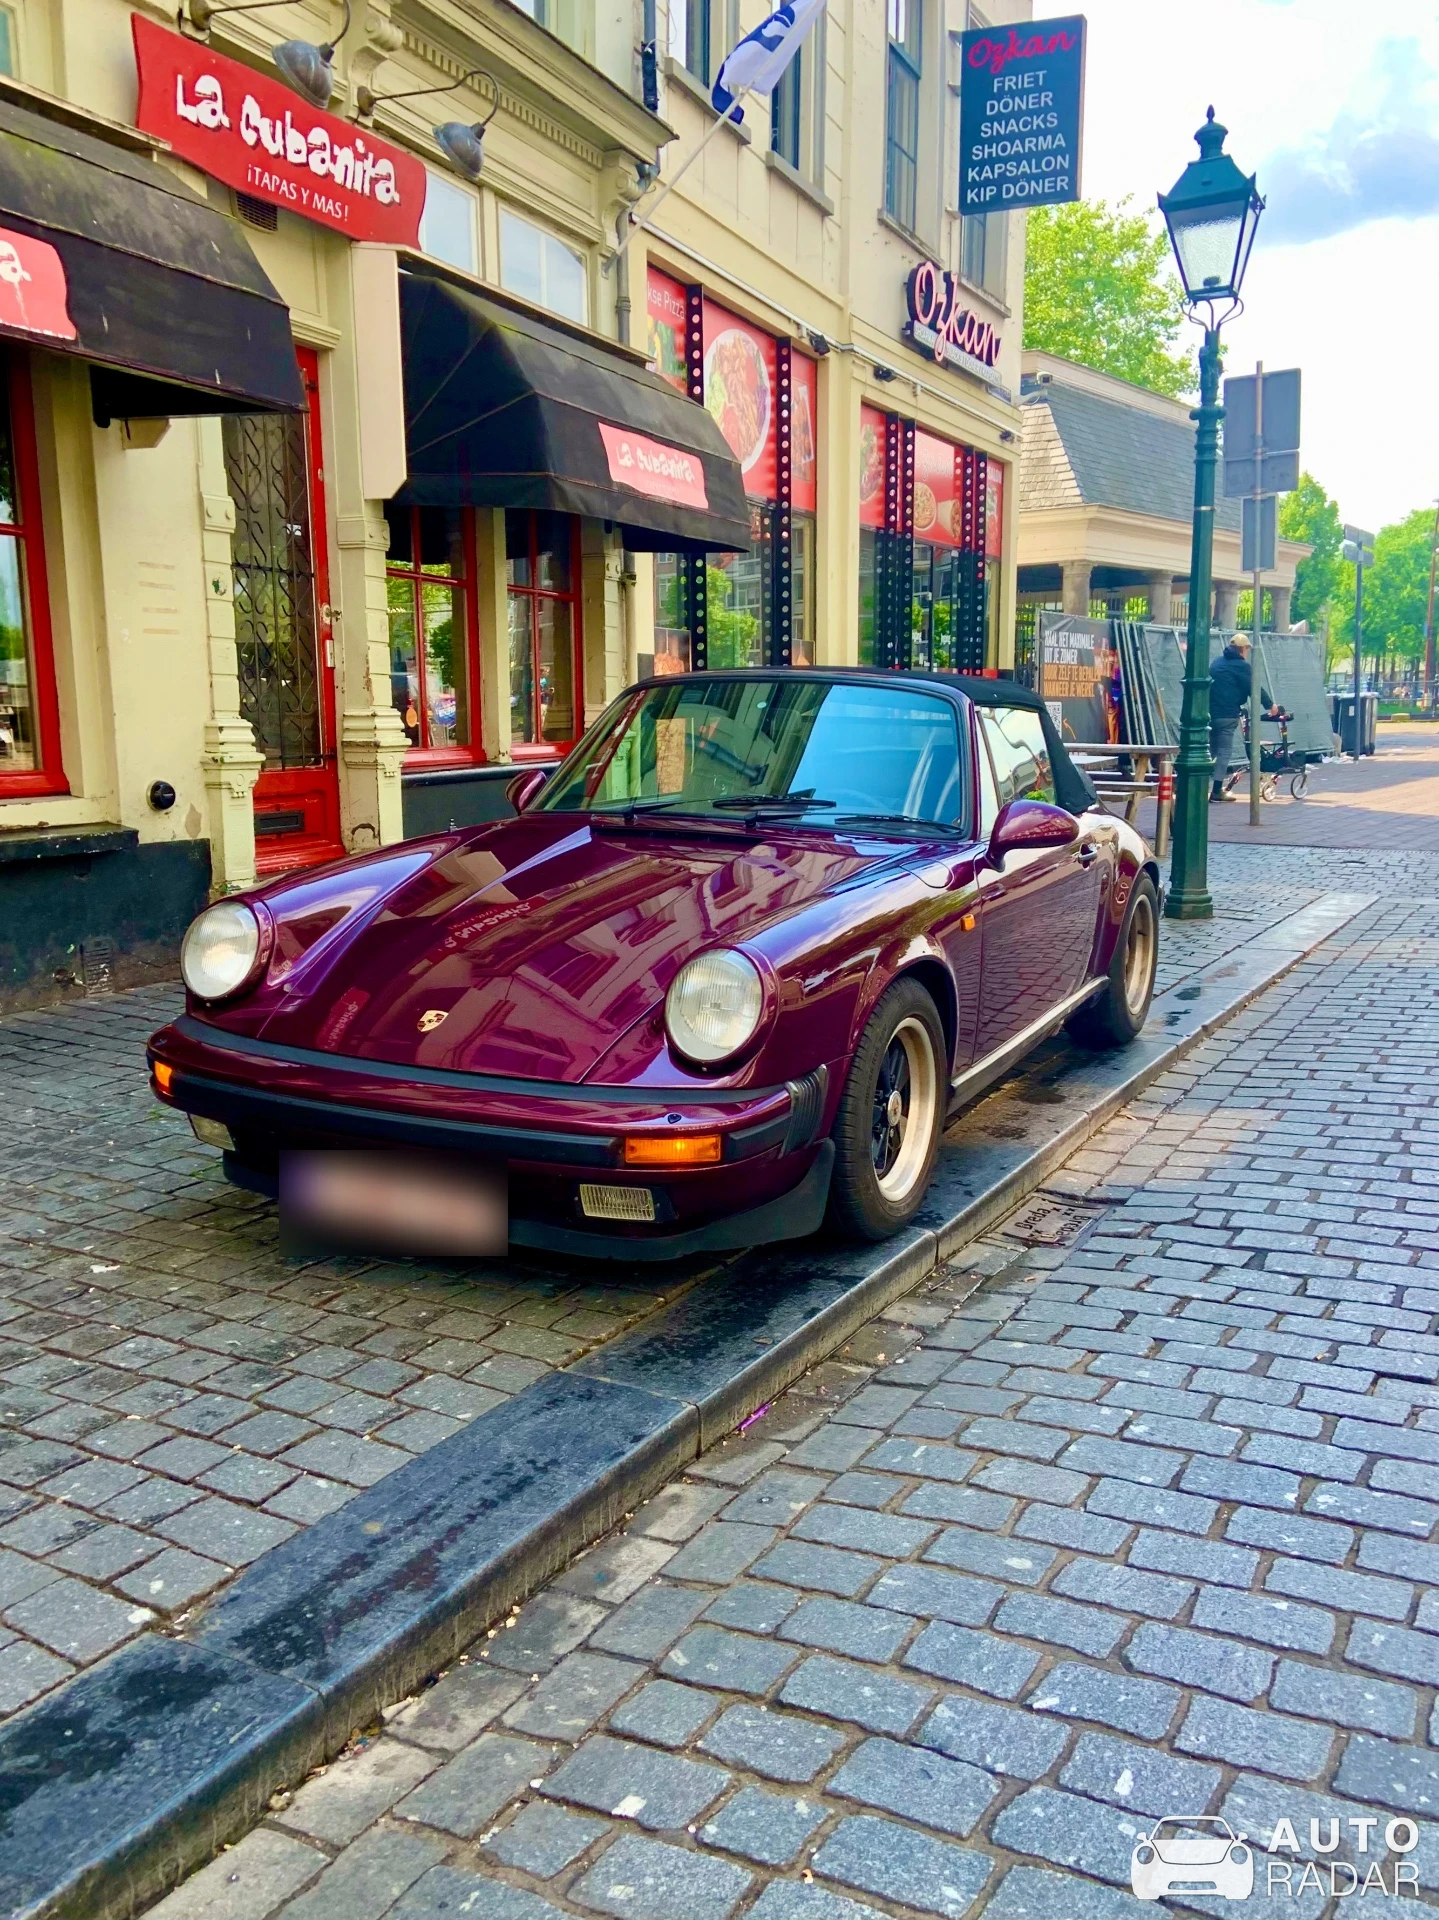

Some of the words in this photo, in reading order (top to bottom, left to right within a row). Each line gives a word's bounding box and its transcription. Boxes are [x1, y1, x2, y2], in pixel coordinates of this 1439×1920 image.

[968, 30, 1077, 74] Ozkan
[993, 70, 1048, 93] FRIET
[986, 91, 1053, 116] DÖNER
[980, 112, 1058, 138] SNACKS
[176, 74, 230, 129] La
[239, 94, 400, 204] Cubanita
[971, 132, 1066, 161] SHOARMA
[967, 153, 1070, 183] KAPSALON
[300, 187, 310, 204] Y
[966, 185, 997, 204] KIP
[1002, 175, 1069, 199] DÖNER
[664, 290, 685, 320] Pizza
[911, 260, 1002, 367] Ozkan
[615, 442, 635, 468] La
[1053, 648, 1060, 664] JE
[1060, 648, 1078, 664] ZOMER
[1059, 664, 1071, 680] ZELF
[1072, 665, 1078, 681] TE
[1070, 681, 1075, 697] JE
[1014, 1207, 1051, 1230] Breda
